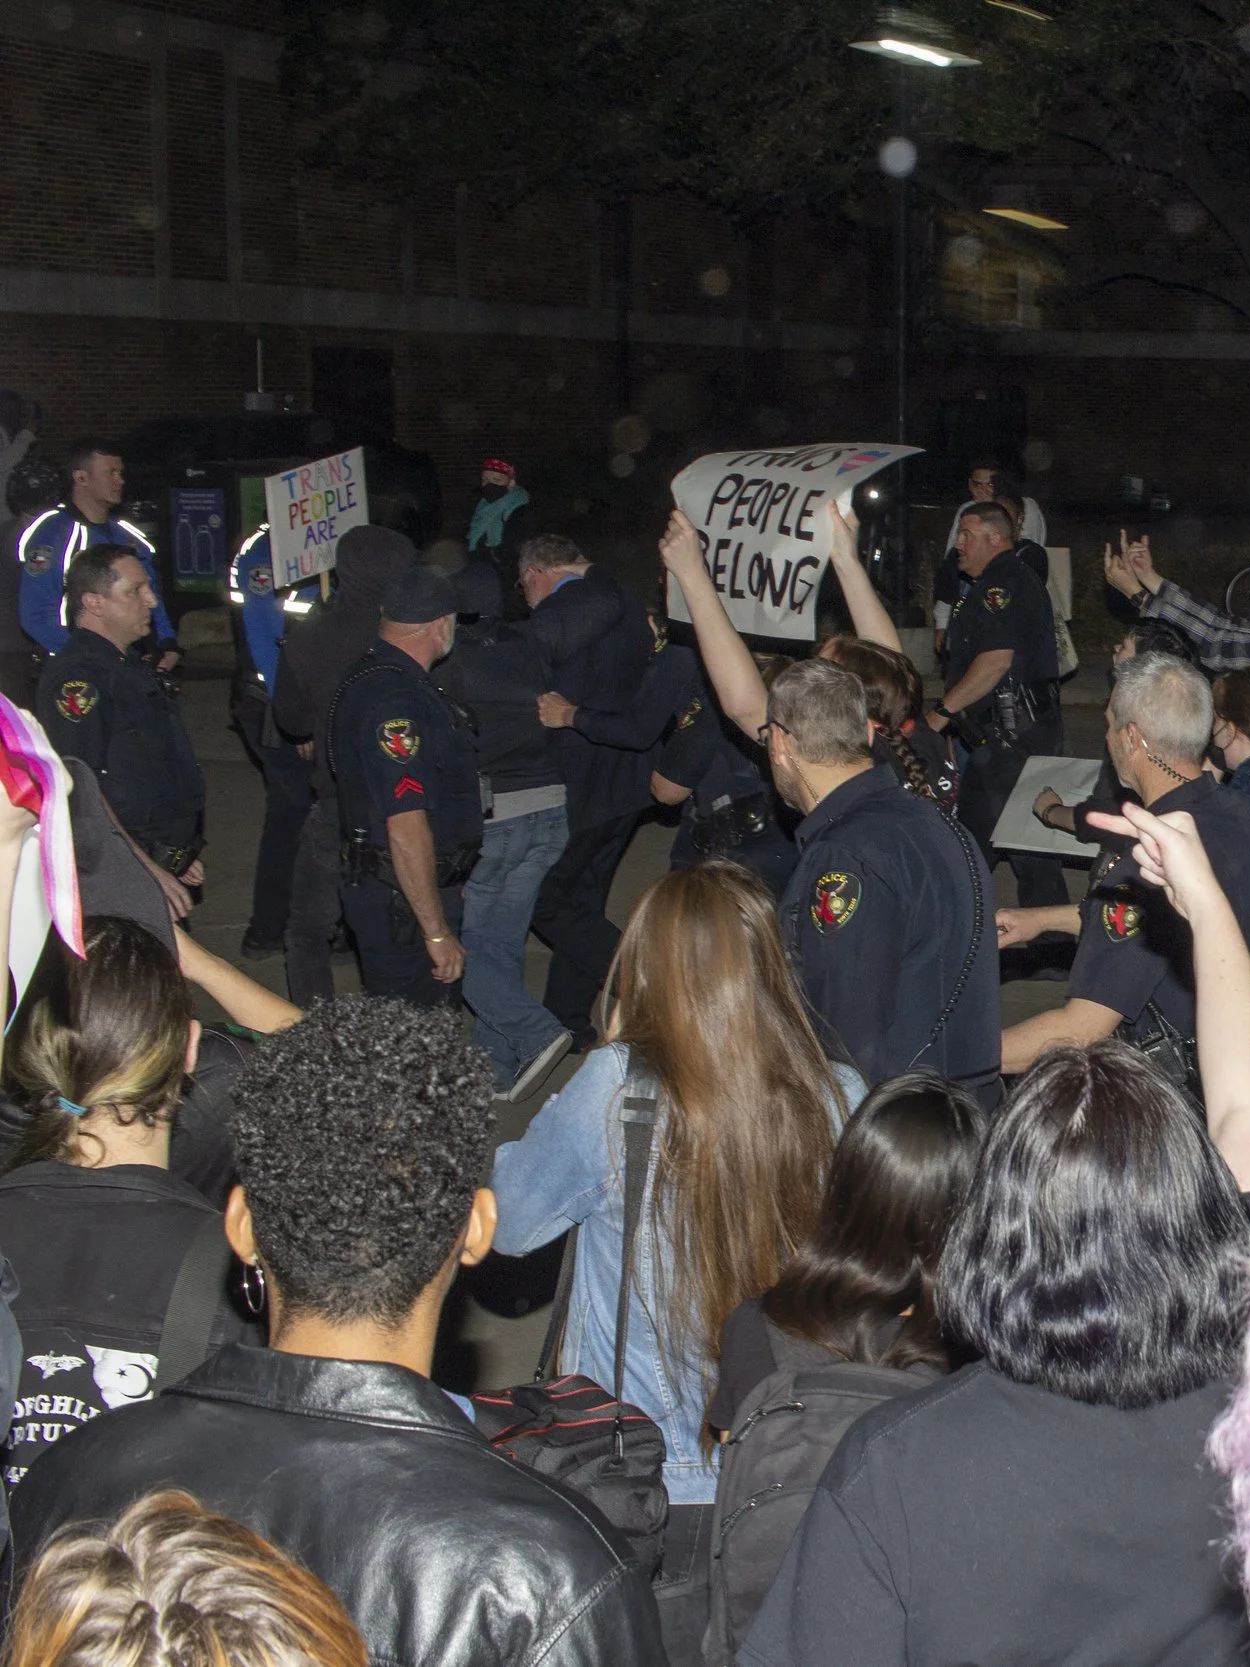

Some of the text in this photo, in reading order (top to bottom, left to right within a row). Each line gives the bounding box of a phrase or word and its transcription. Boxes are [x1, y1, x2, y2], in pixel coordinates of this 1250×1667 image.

[281, 454, 353, 499] TRANS
[288, 482, 357, 530] PEOPLE
[704, 473, 826, 542] PEOPLE
[304, 516, 338, 550] ARE
